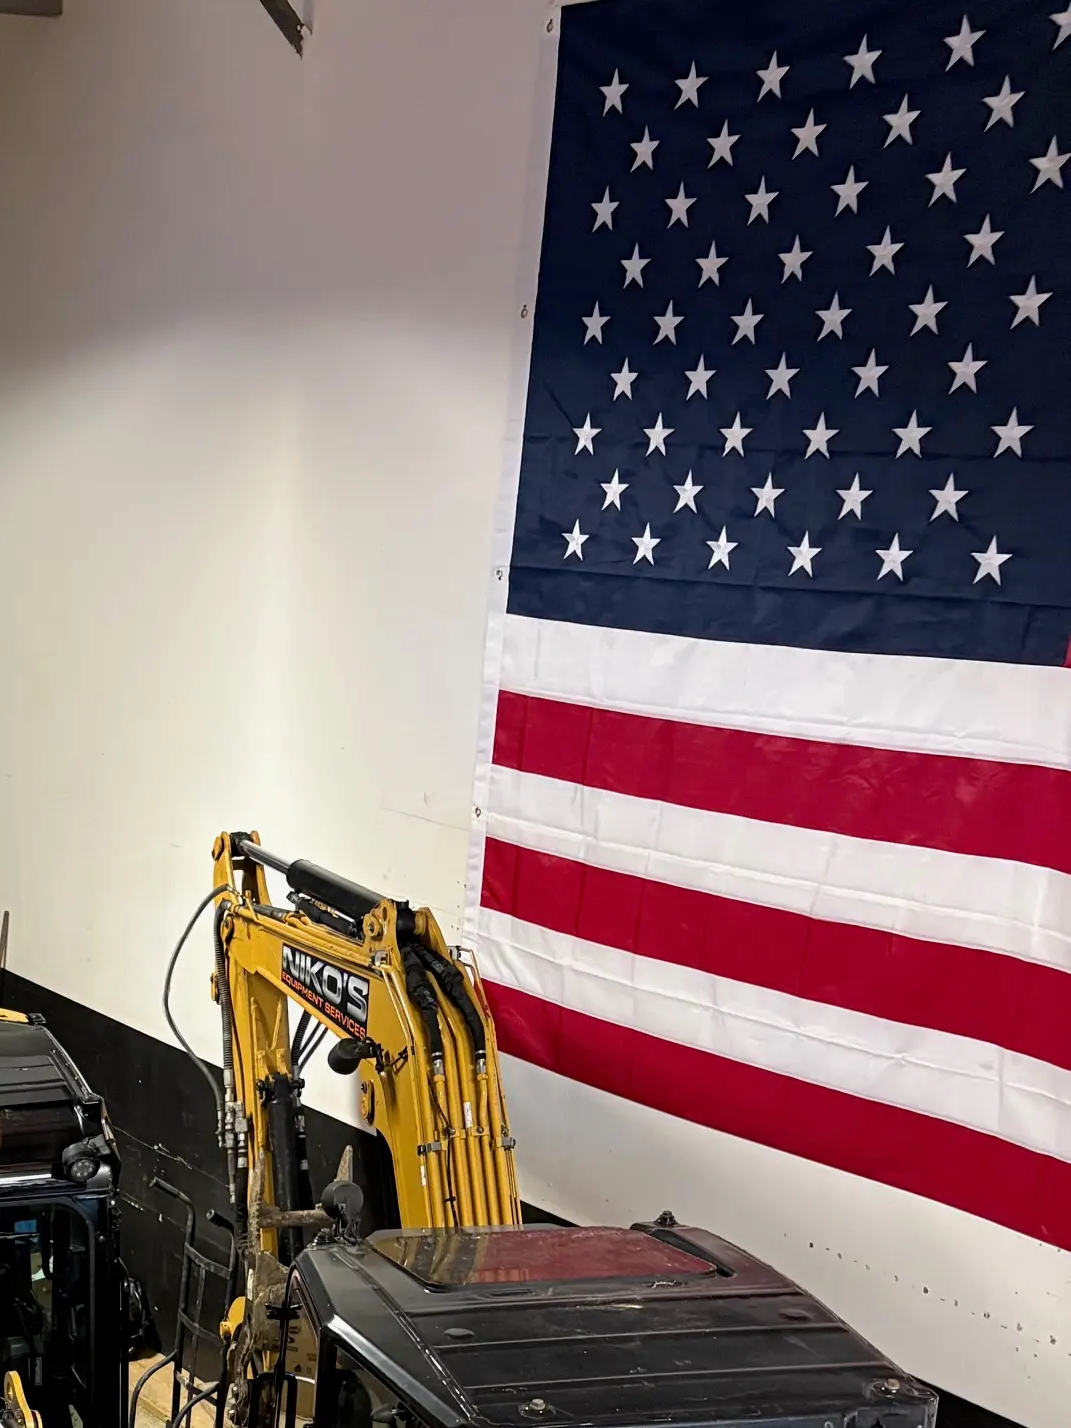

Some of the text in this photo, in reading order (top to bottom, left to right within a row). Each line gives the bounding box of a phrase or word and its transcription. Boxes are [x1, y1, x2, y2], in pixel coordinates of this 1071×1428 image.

[282, 945, 369, 1023] NIKO'S
[282, 971, 366, 1039] EQUIPMENT SERVICES
